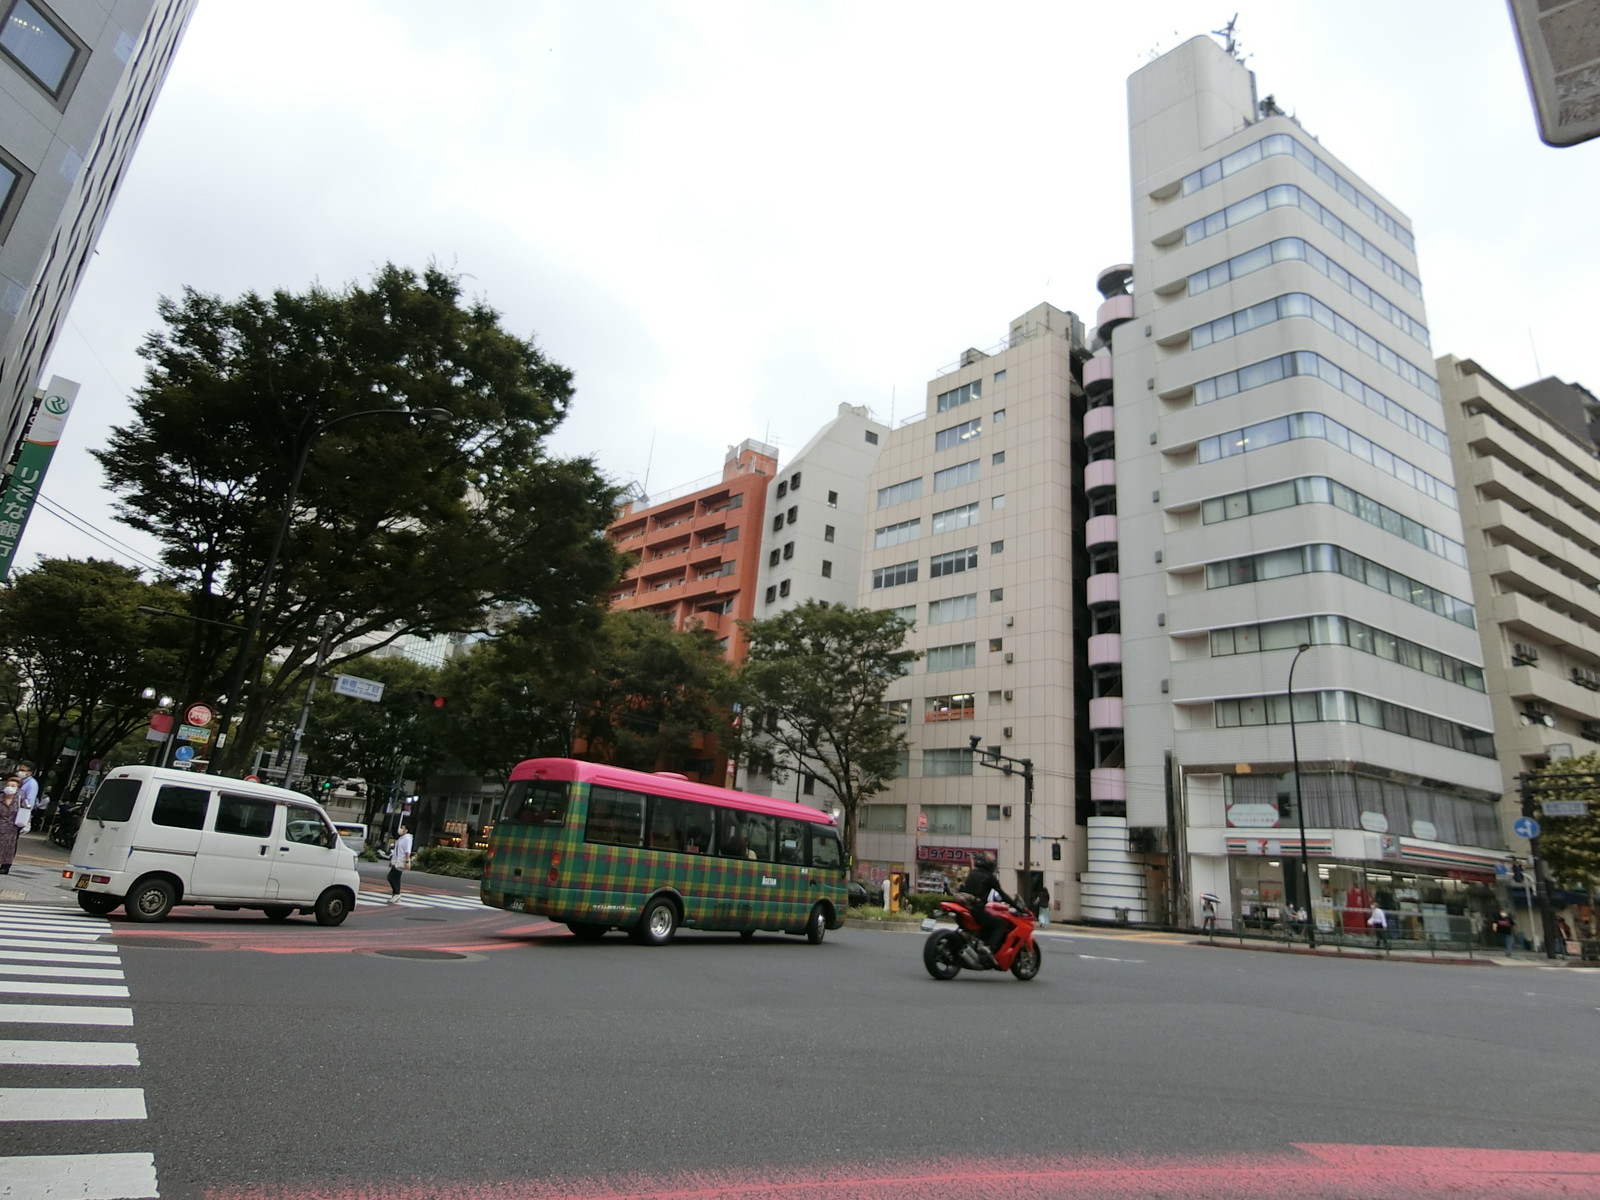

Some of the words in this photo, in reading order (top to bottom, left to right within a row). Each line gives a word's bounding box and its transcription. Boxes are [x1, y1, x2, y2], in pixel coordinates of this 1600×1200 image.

[0, 467, 40, 557] りそな銀行
